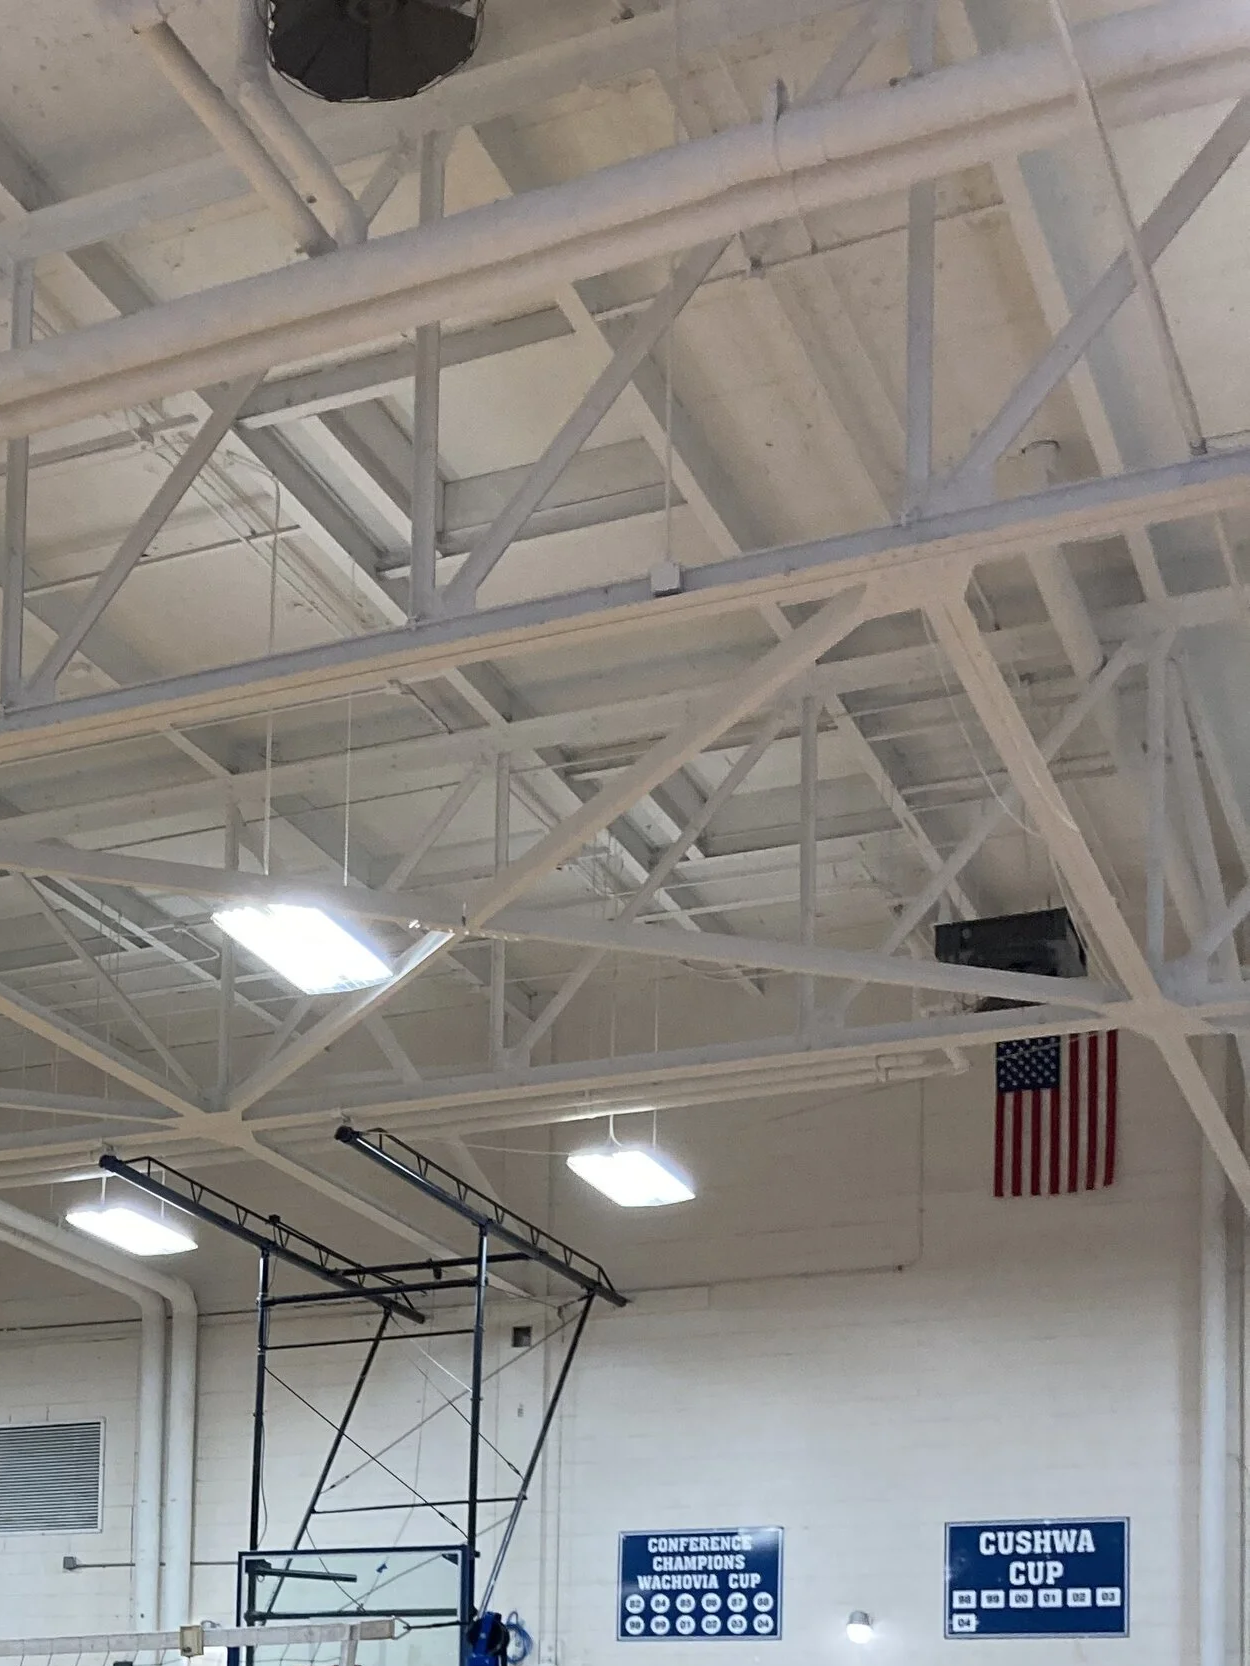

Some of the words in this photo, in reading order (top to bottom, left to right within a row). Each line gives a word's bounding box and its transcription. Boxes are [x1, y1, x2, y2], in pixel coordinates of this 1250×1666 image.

[647, 1535, 753, 1553] CONFERENCE
[979, 1528, 1096, 1556] CUSHWA
[652, 1554, 746, 1572] CHAMPIONS
[637, 1573, 720, 1591] WACHOVIA
[728, 1573, 762, 1589] CUP
[1009, 1561, 1064, 1586] CUP
